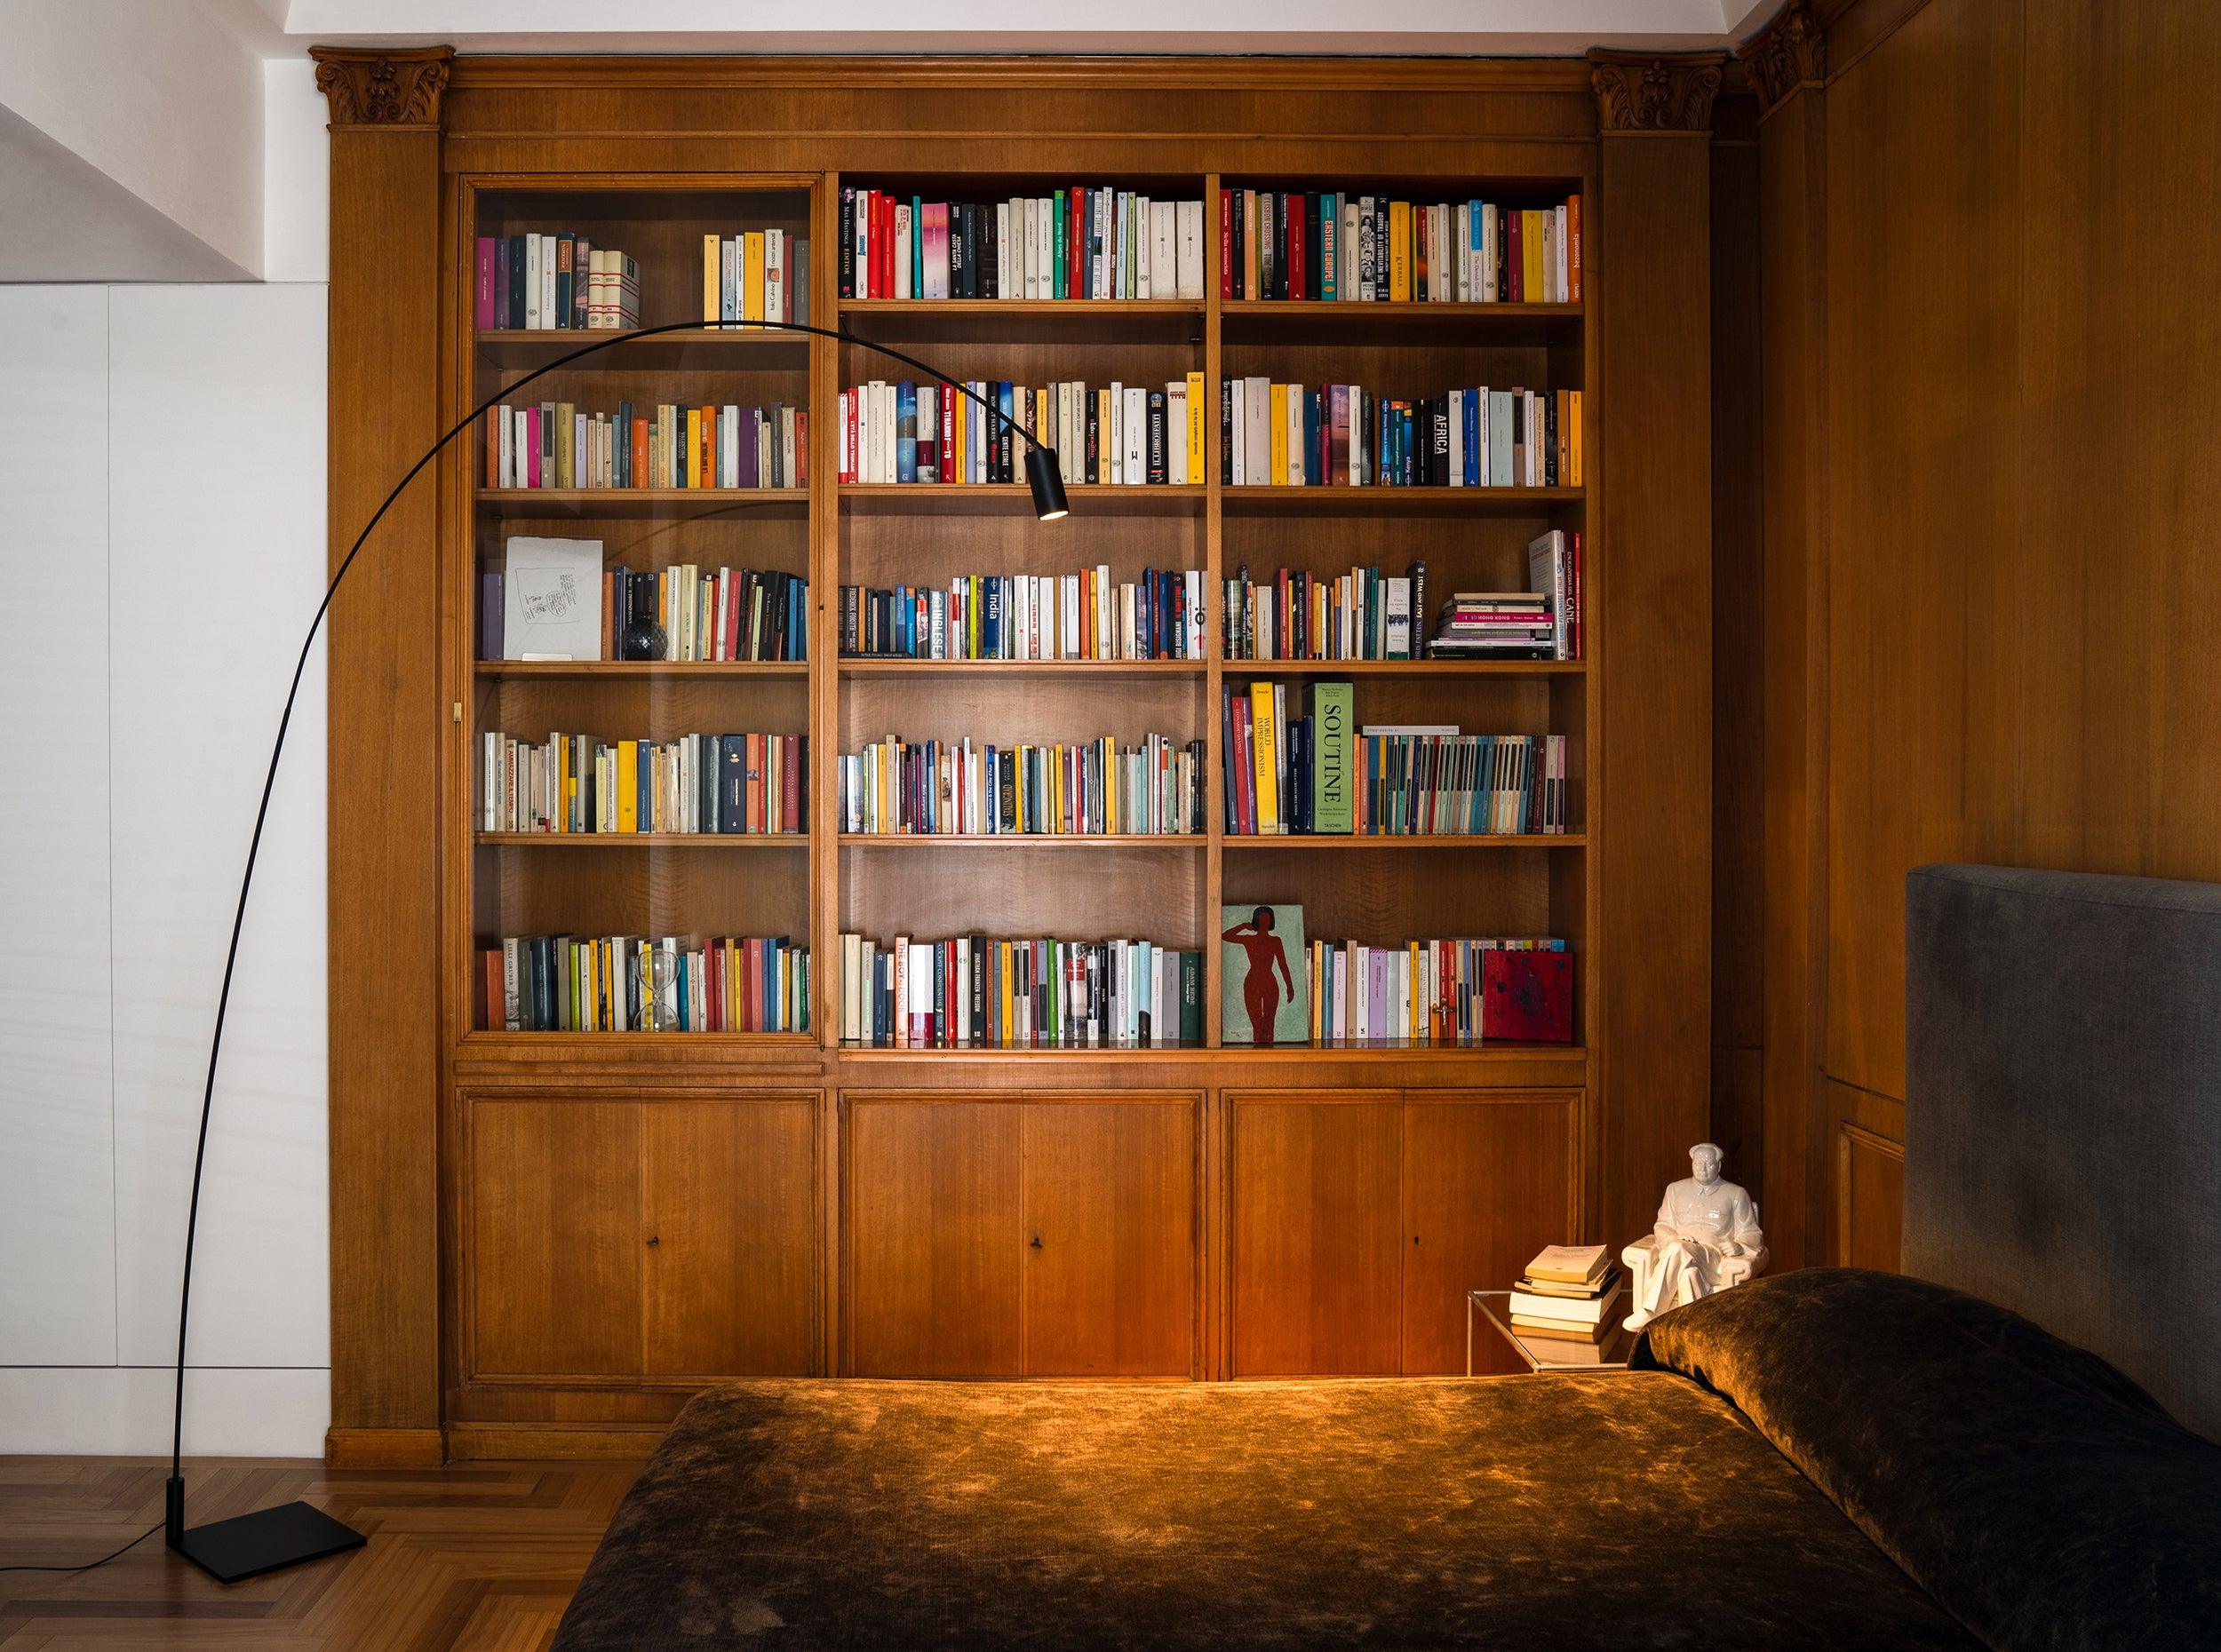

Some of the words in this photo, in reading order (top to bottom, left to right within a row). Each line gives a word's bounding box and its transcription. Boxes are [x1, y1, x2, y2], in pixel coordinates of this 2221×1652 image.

[1324, 221, 1334, 250] EASTERN
[1324, 253, 1334, 282] EUROPE!
[1436, 415, 1448, 454] AFRICA
[989, 594, 999, 620] India
[932, 609, 943, 651] INGLESE
[1257, 718, 1266, 777] IMPRESSIONISM
[1324, 705, 1341, 803] SOUTINE
[1003, 784, 1013, 817] STALINGRAD
